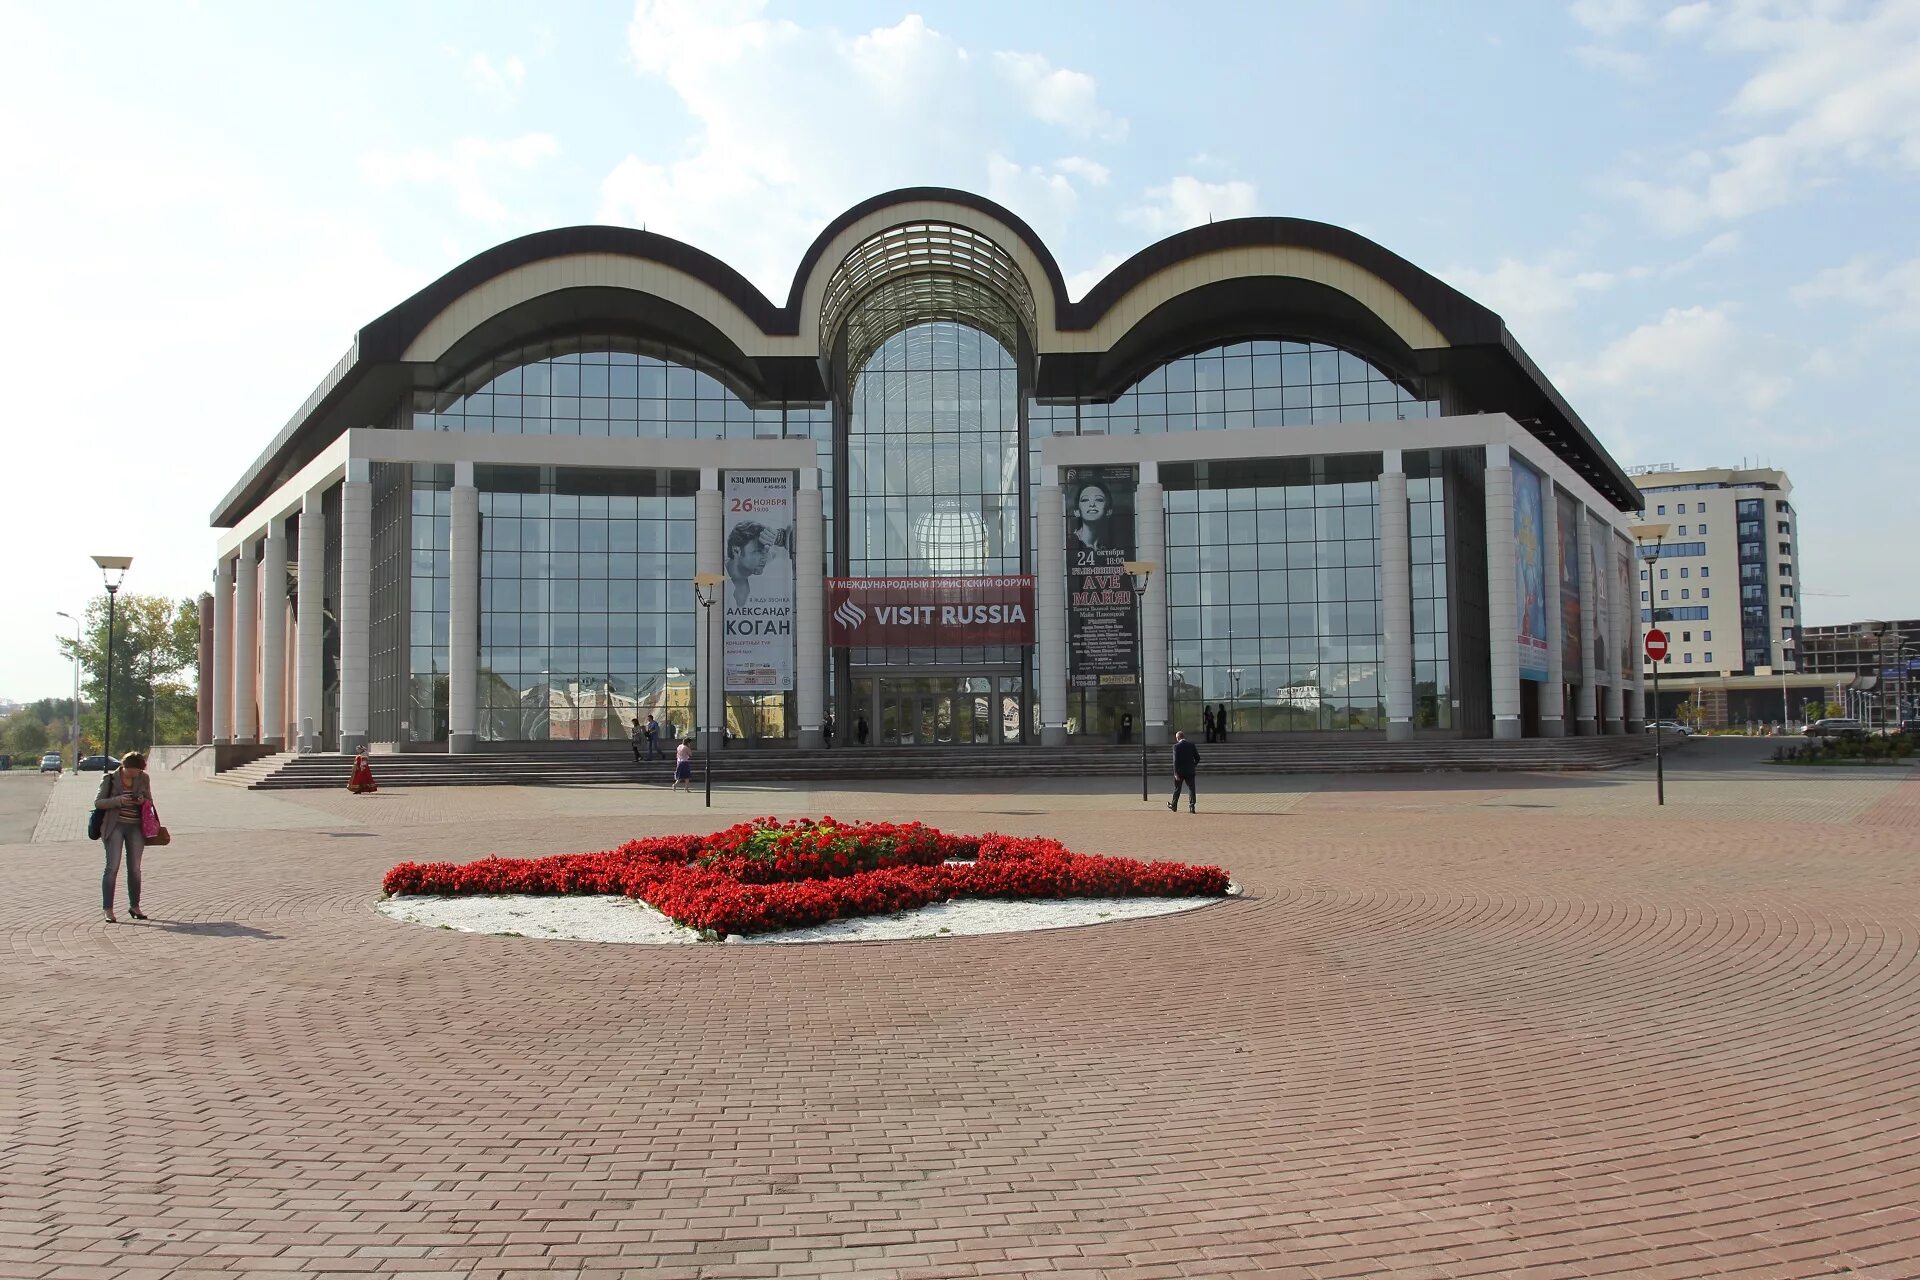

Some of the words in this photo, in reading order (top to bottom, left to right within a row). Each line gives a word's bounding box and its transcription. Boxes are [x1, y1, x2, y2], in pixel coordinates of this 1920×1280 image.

[731, 476, 744, 484] КЗЦ
[731, 498, 753, 512] 26
[1077, 551, 1095, 566] 24
[829, 580, 836, 588] V
[838, 578, 930, 590] МЕЖДУНАРОДНЫЙ
[931, 578, 993, 589] ТУРИСТСКИЙ
[995, 578, 1031, 587] ФОРУМ
[1083, 575, 1121, 589] AVE
[1073, 589, 1131, 606] МАЙЯ!
[726, 607, 790, 617] АЛЕКСАНДР
[874, 606, 935, 625] VISIT
[942, 604, 1026, 624] RUSSIA
[726, 620, 790, 635] КОГАН
